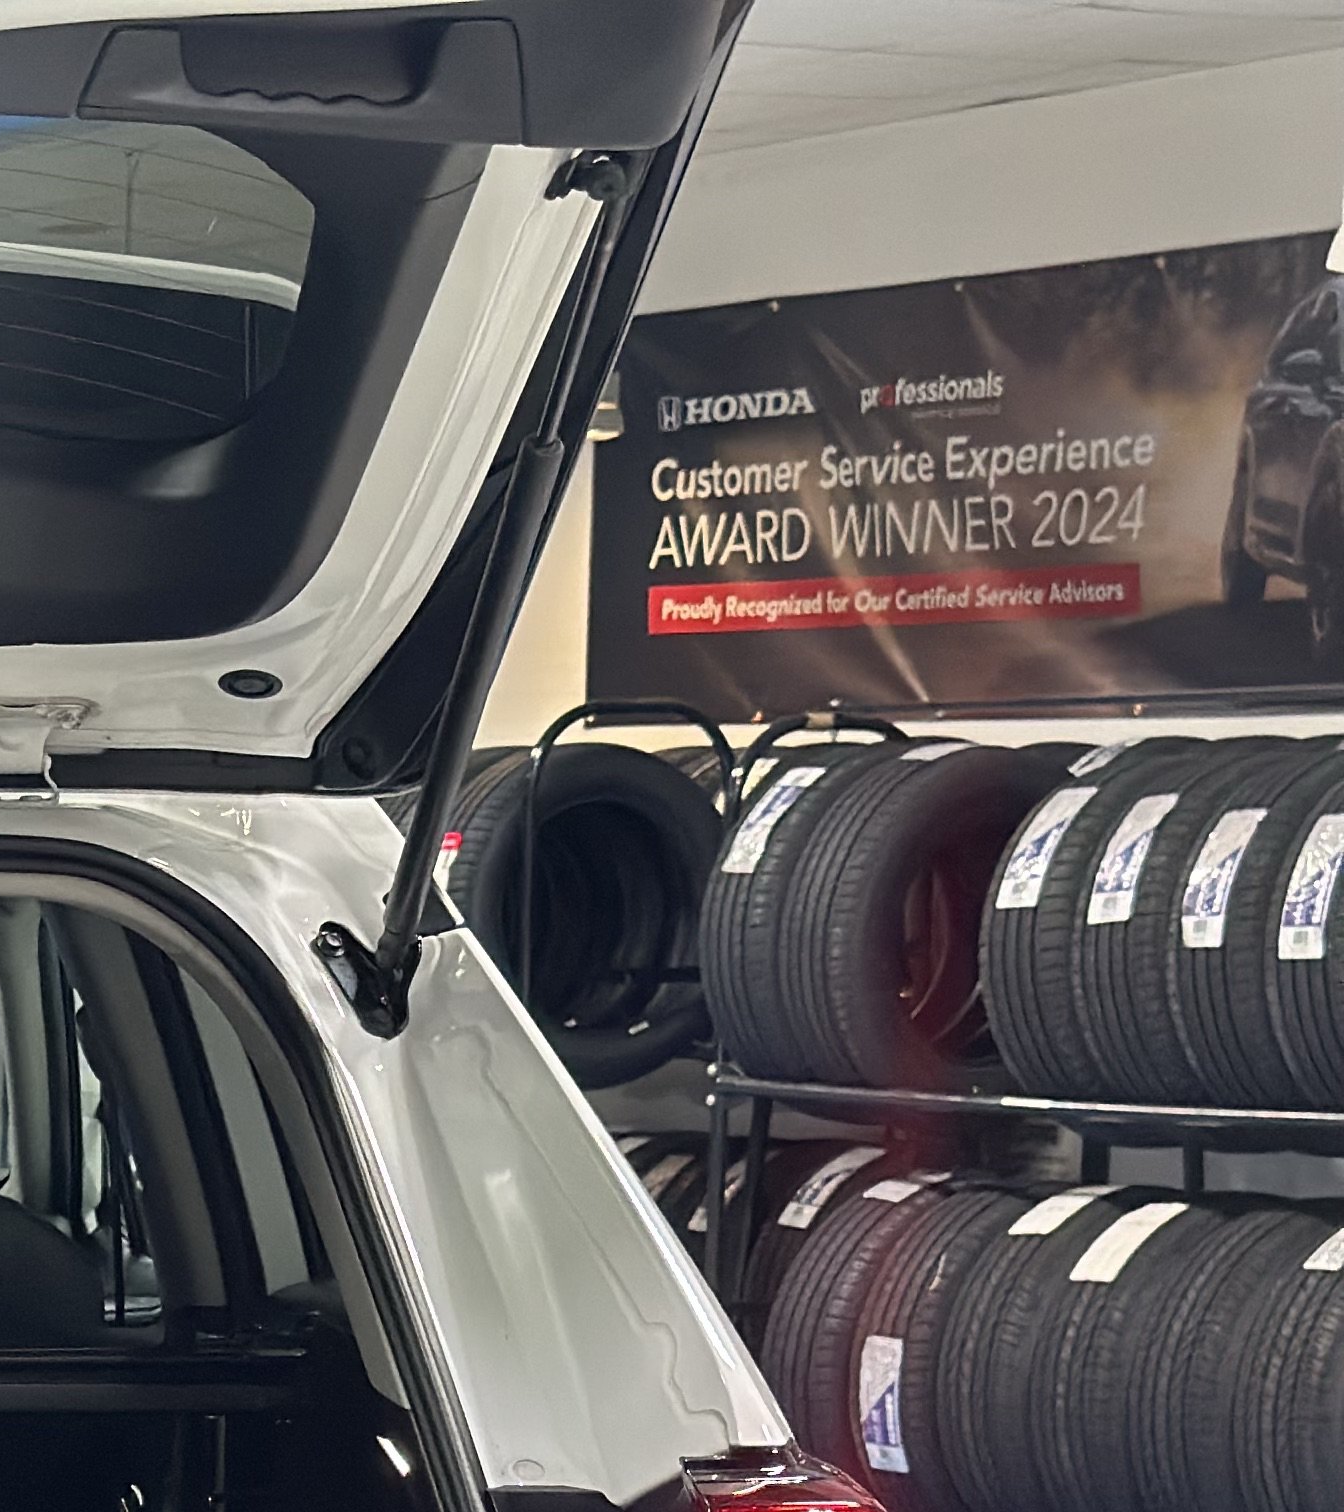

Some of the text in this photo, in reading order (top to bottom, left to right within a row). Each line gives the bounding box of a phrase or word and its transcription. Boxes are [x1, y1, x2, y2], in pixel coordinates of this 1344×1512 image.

[685, 387, 817, 426] HONDA
[650, 428, 1156, 501] Customer Service Experience
[648, 483, 1147, 571] AWARD WINNER 2024
[661, 579, 1125, 625] Proudly Recognized for Our Certified Service Advisors
